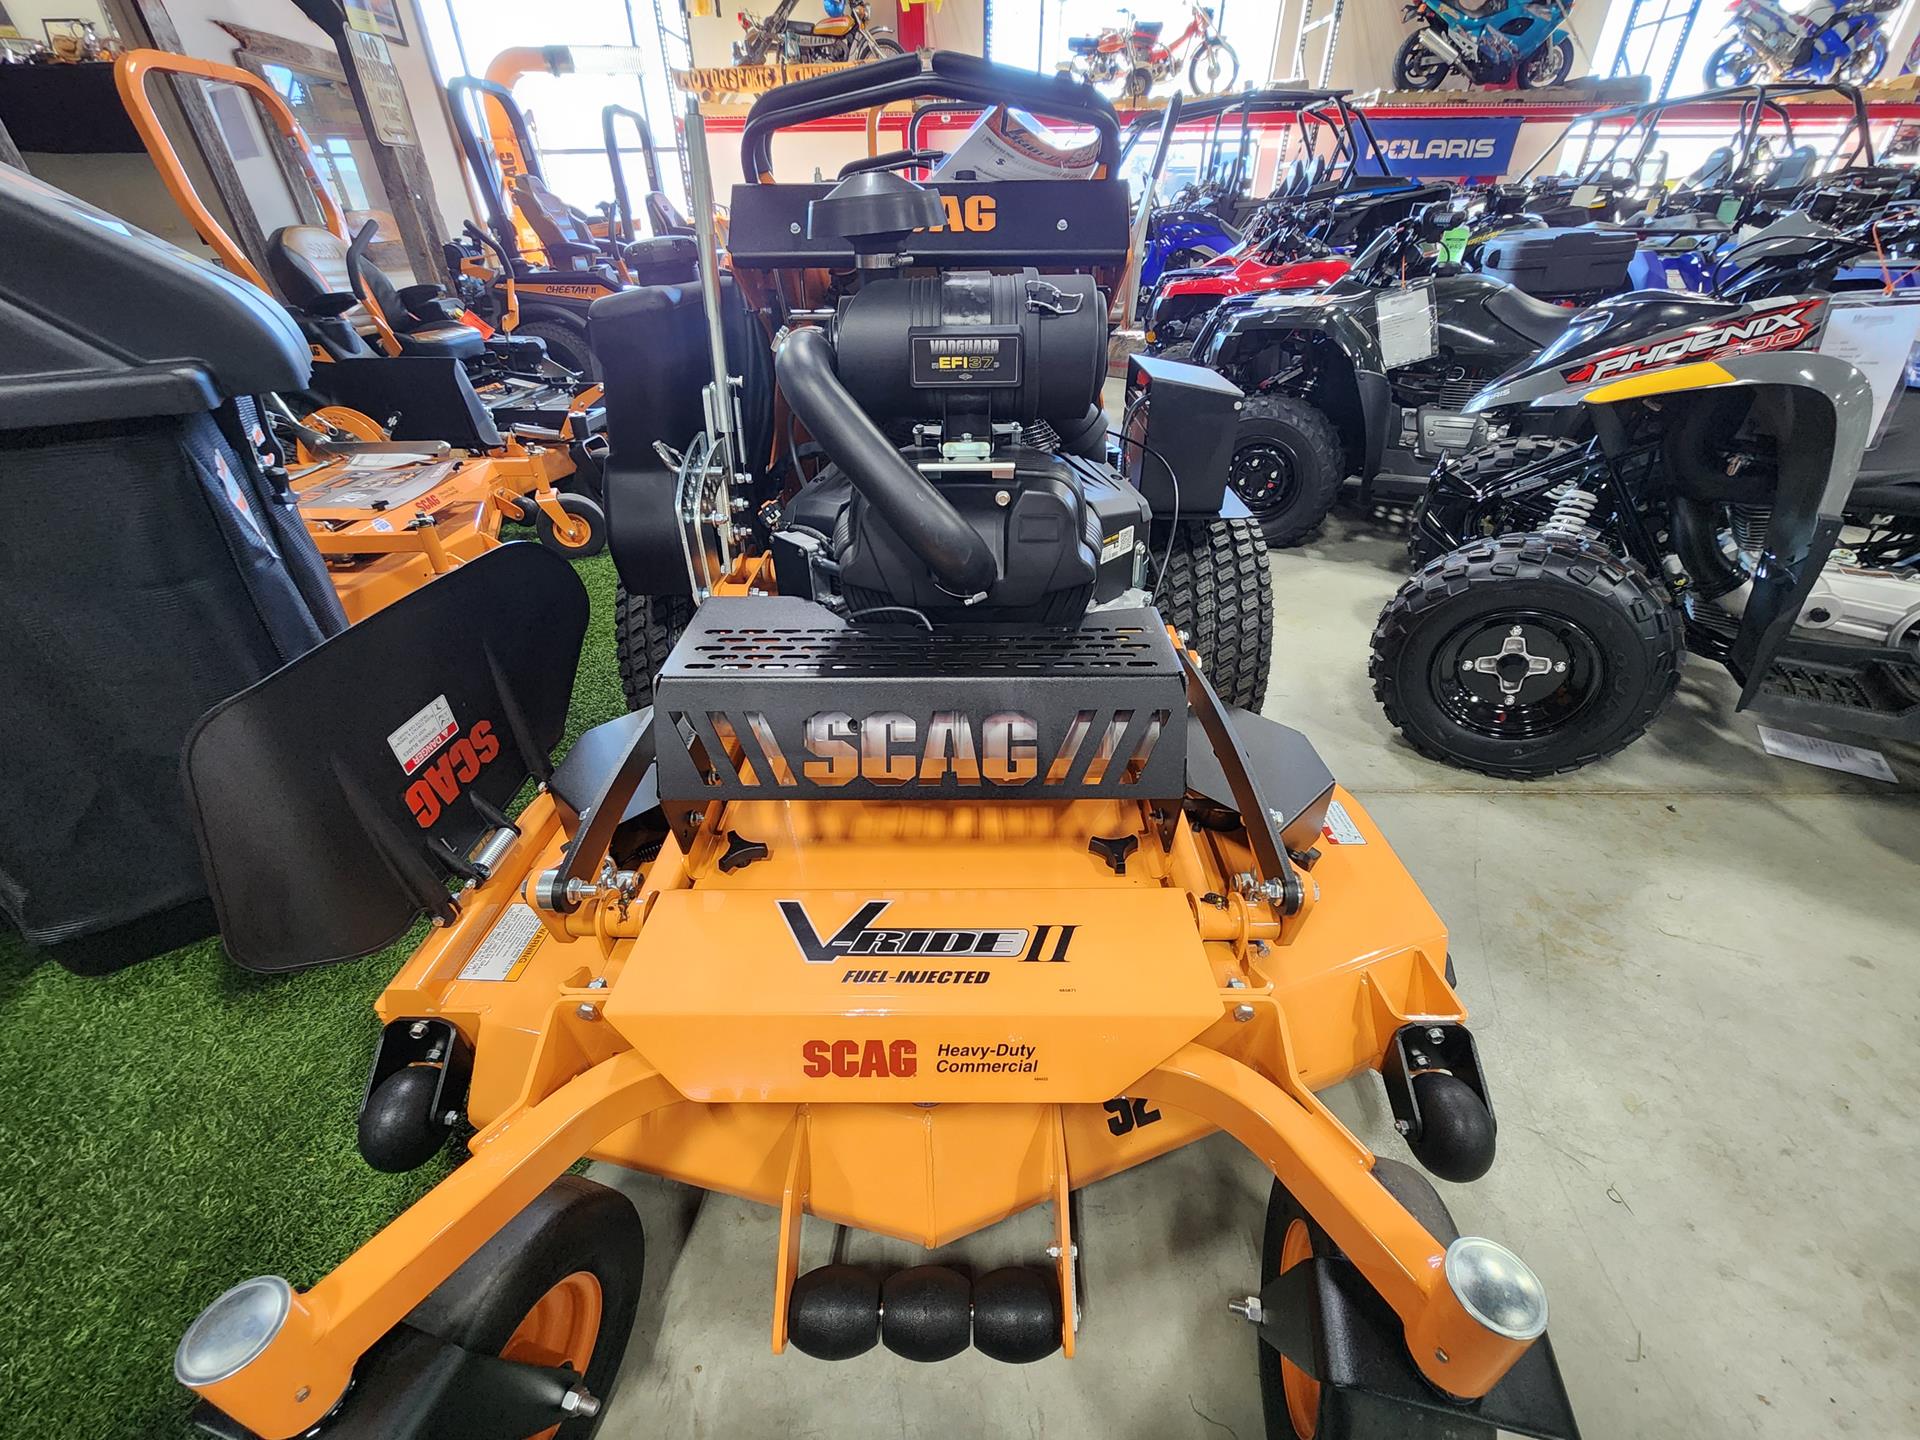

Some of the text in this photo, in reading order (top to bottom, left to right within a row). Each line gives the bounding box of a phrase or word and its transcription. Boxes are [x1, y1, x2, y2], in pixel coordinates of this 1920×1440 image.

[359, 32, 380, 60] NO
[1366, 138, 1496, 160] POLARIS
[912, 195, 997, 232] AG
[545, 285, 597, 295] CHEETAH II
[930, 339, 1000, 355] VANGUARD
[1588, 307, 1806, 383] PHOENIX
[1708, 327, 1805, 362] 200
[416, 494, 441, 511] SCAG
[412, 736, 442, 765] DANGER
[802, 711, 1038, 787] SCAG
[404, 720, 500, 829] SCAG
[519, 927, 547, 964] WARNING
[777, 900, 1083, 964] V-RIDE II
[841, 970, 990, 984] FUEL-INJECTED
[802, 1040, 917, 1078] SCAG
[937, 1043, 1036, 1060] Heavy-Duty
[936, 1060, 1038, 1073] Commercial
